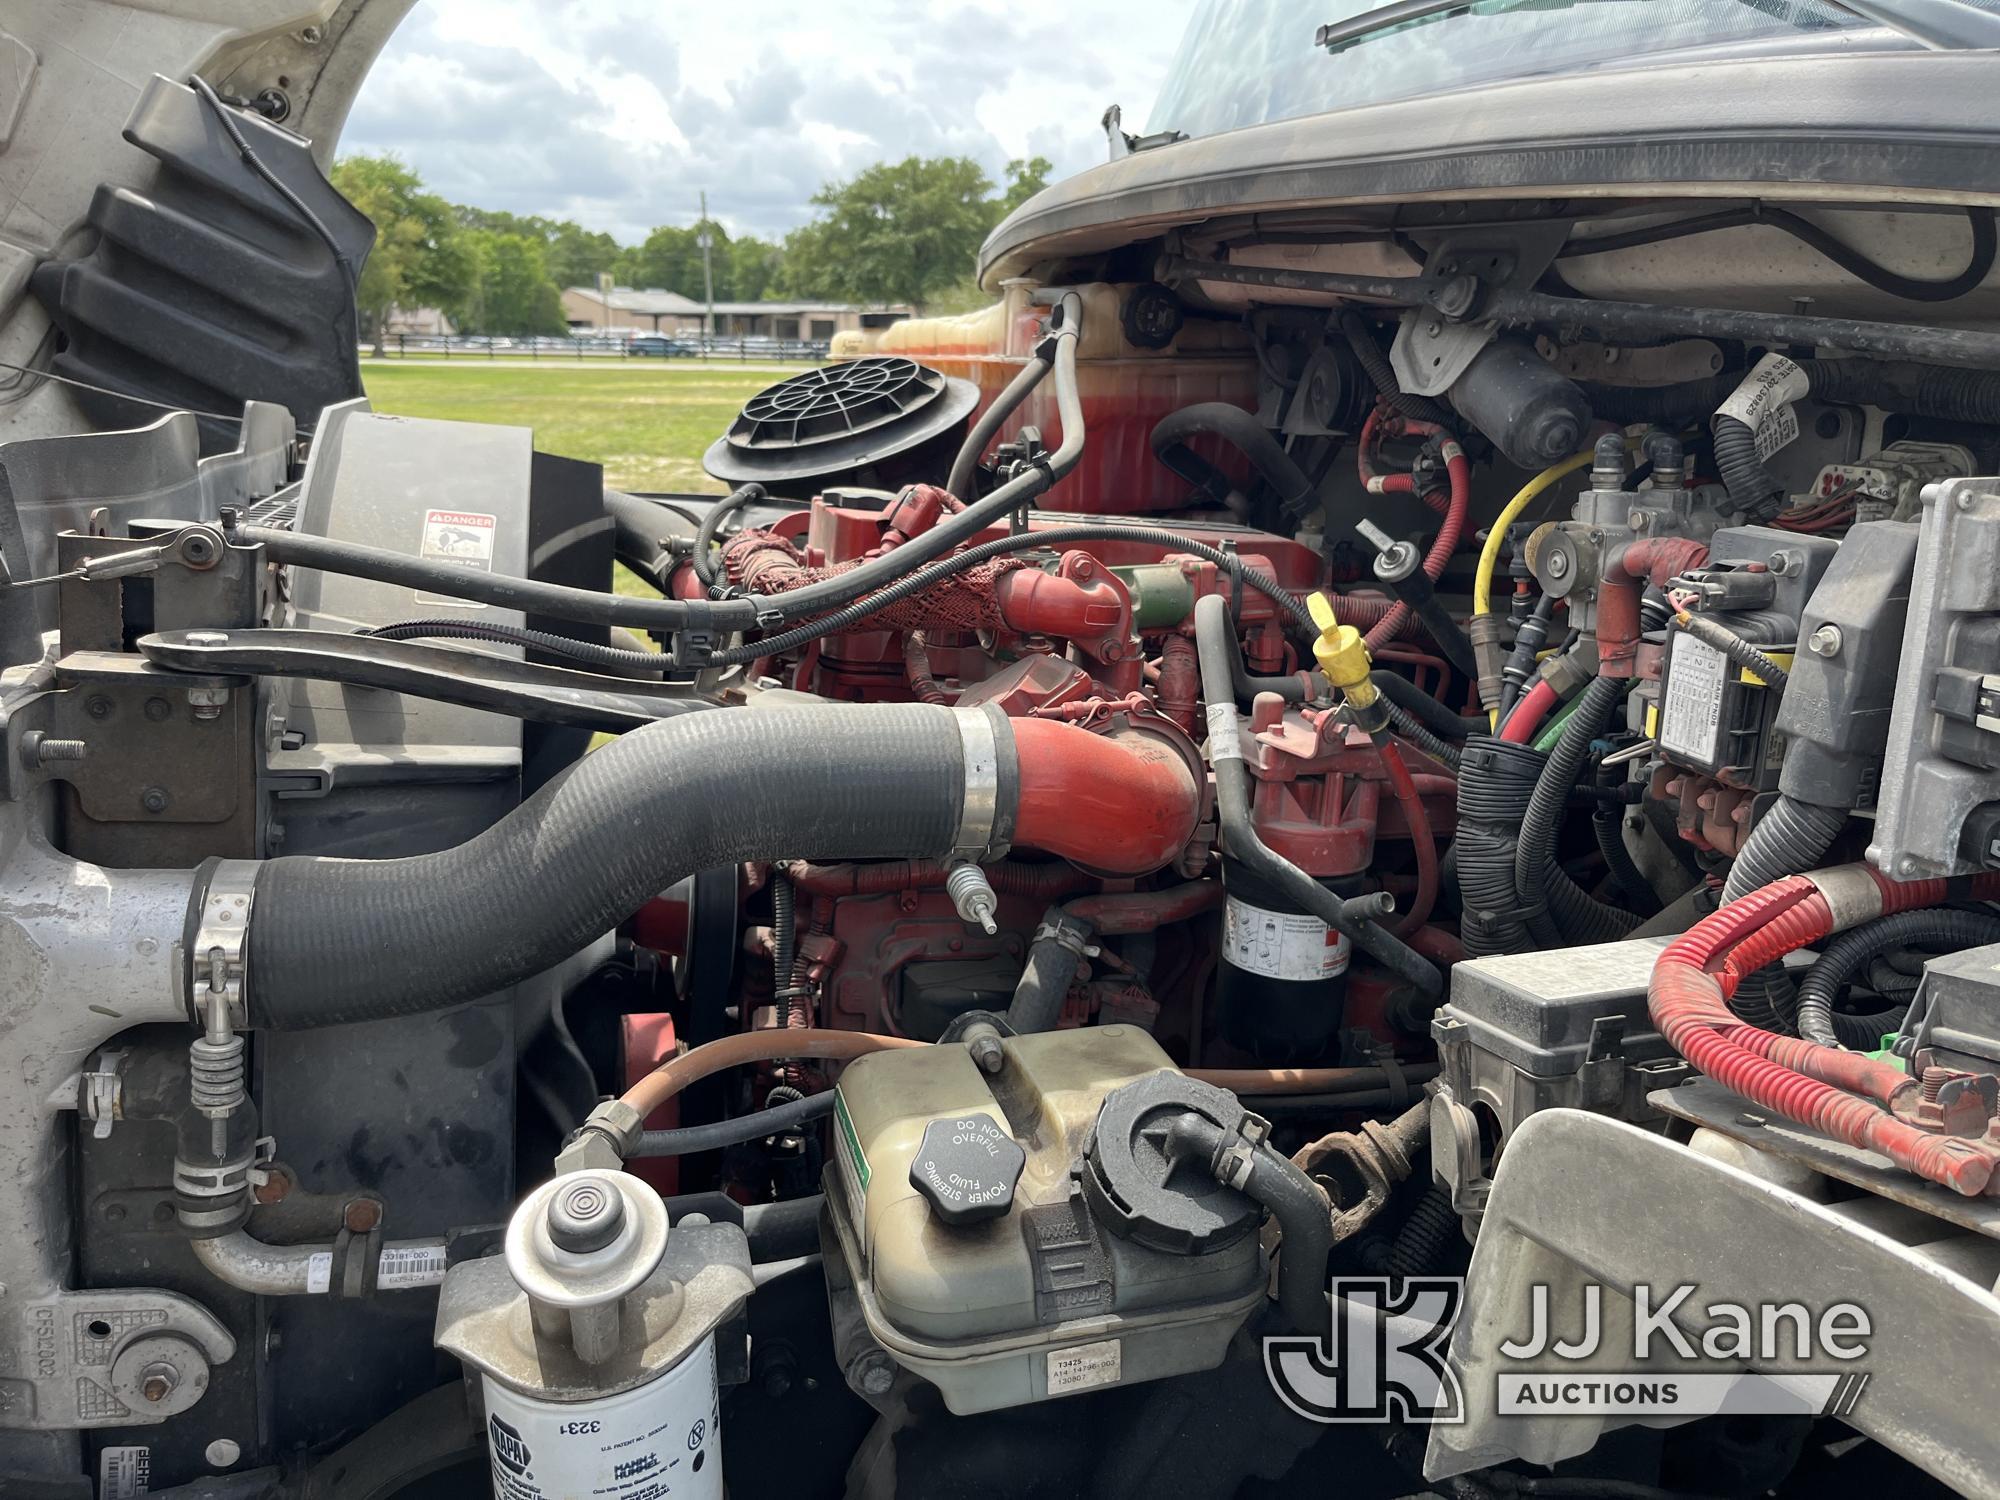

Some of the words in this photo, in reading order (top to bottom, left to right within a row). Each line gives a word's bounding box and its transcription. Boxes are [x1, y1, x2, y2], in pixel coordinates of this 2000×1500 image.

[443, 515, 492, 526] DANGER
[1711, 703, 1719, 726] PNDB
[957, 1120, 975, 1130] DO
[982, 1124, 1005, 1141] NOT
[953, 1133, 1000, 1157] OVERFILL
[925, 1160, 962, 1201] STEERING
[949, 1173, 980, 1190] FLUID
[968, 1181, 1007, 1203] POWER
[559, 1420, 600, 1434] 3231
